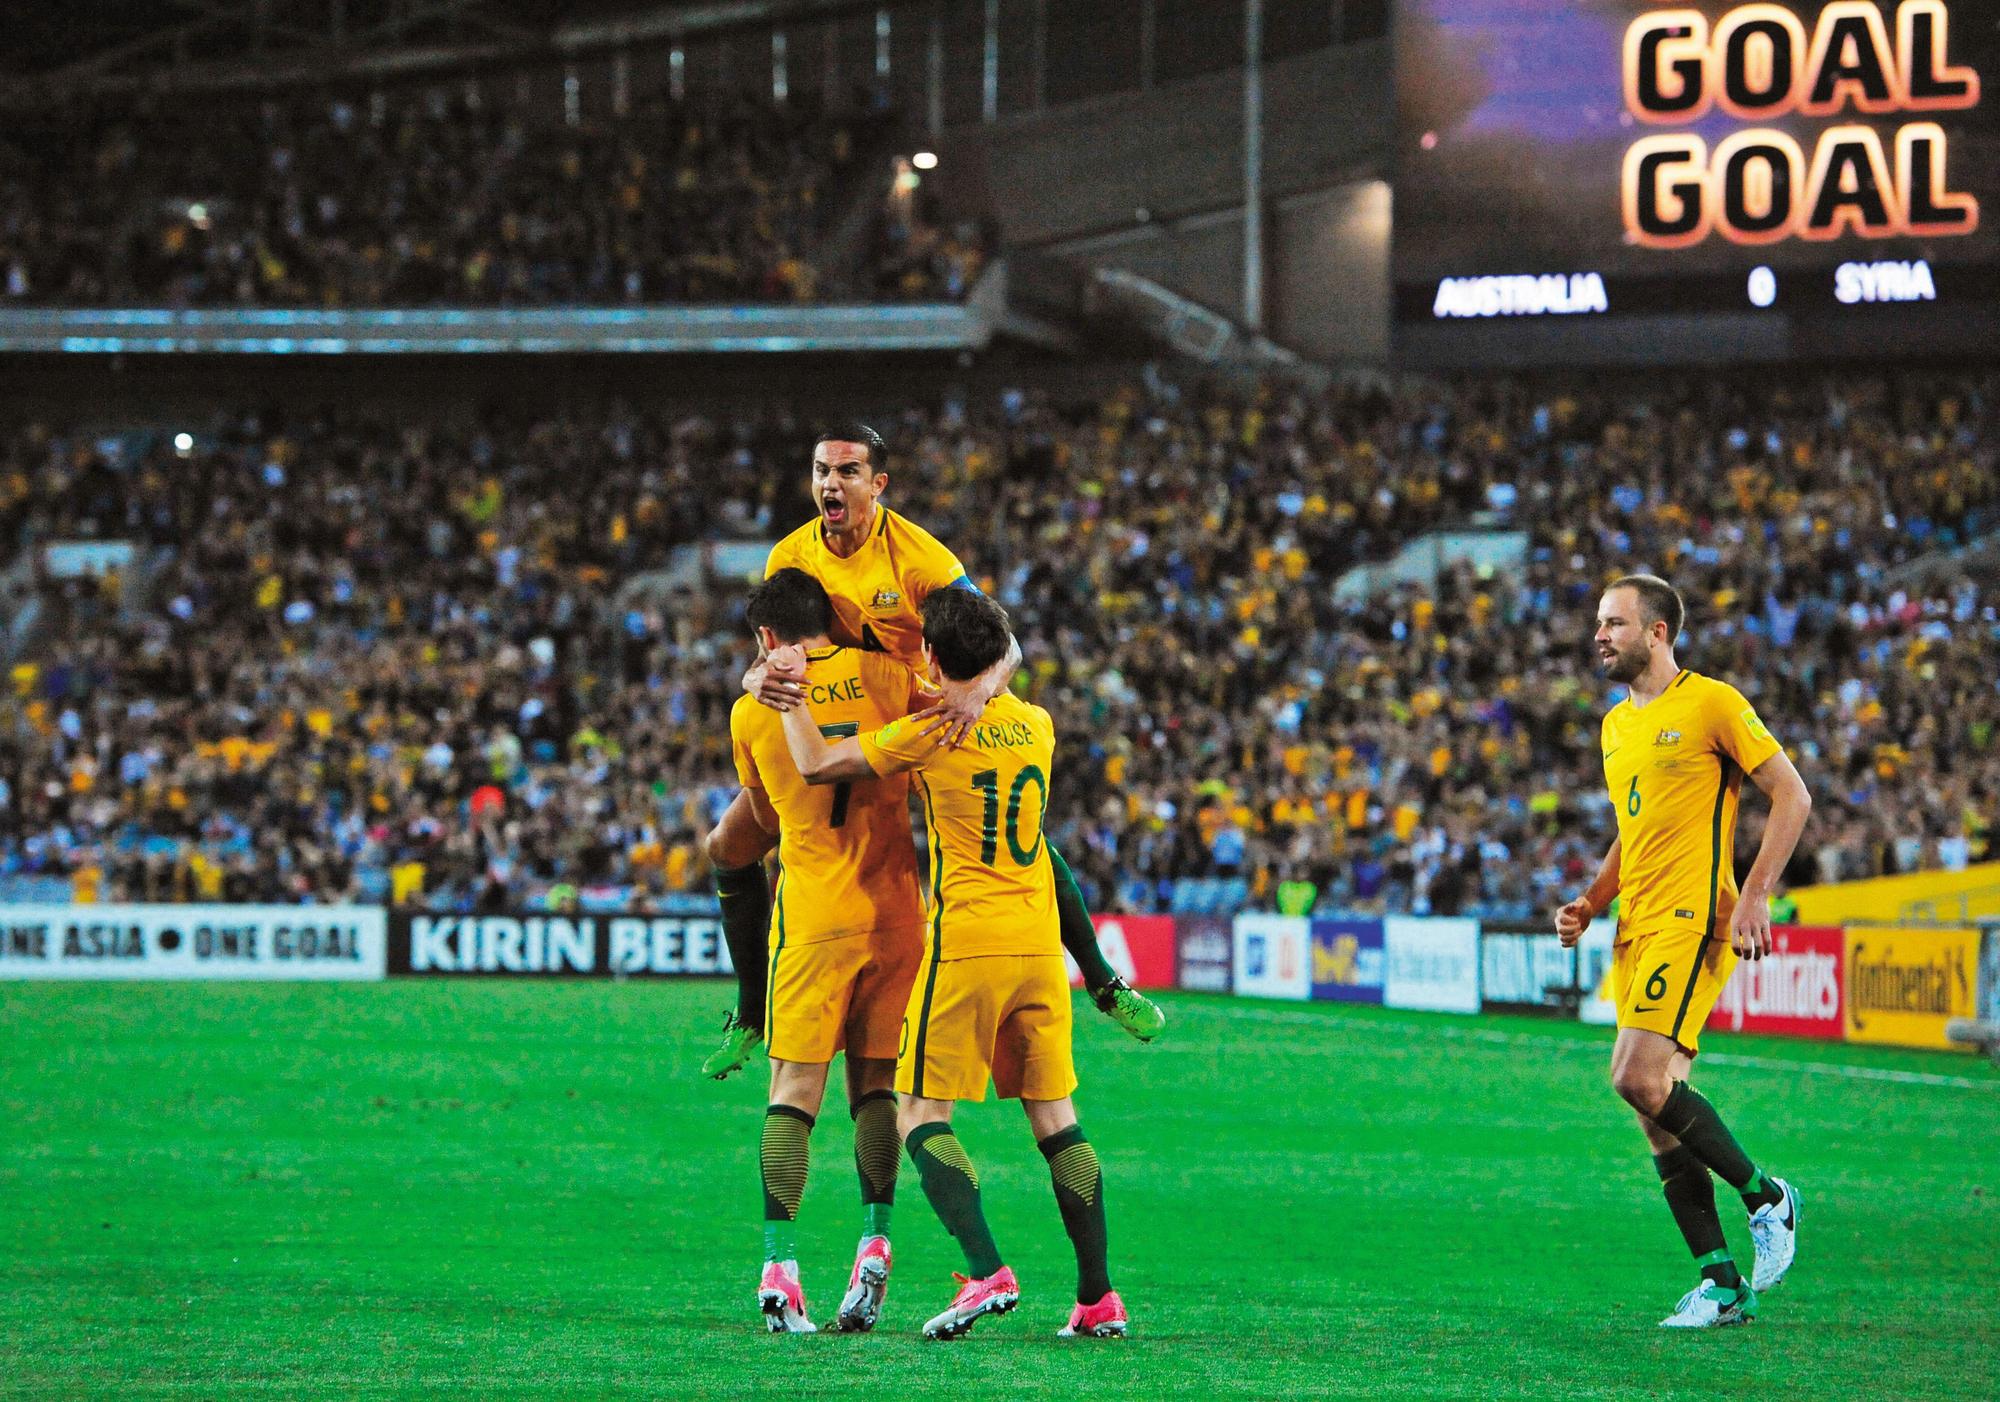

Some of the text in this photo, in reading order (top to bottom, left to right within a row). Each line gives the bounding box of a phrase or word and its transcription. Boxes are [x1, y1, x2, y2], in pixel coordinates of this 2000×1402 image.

[1622, 0, 1980, 120] GOAL
[1622, 123, 1979, 248] GOAL
[1433, 259, 1936, 318] AUSTRALIA 0 SYRIA
[800, 677, 864, 704] CKIE
[975, 723, 1033, 748] KRUSE
[971, 764, 1047, 868] 10
[1627, 775, 1642, 818] 6
[63, 924, 147, 958] ASIA
[194, 923, 259, 960] ONE
[273, 923, 361, 960] GOAL
[409, 915, 597, 973] KIRIN
[1645, 963, 1670, 1001] 6
